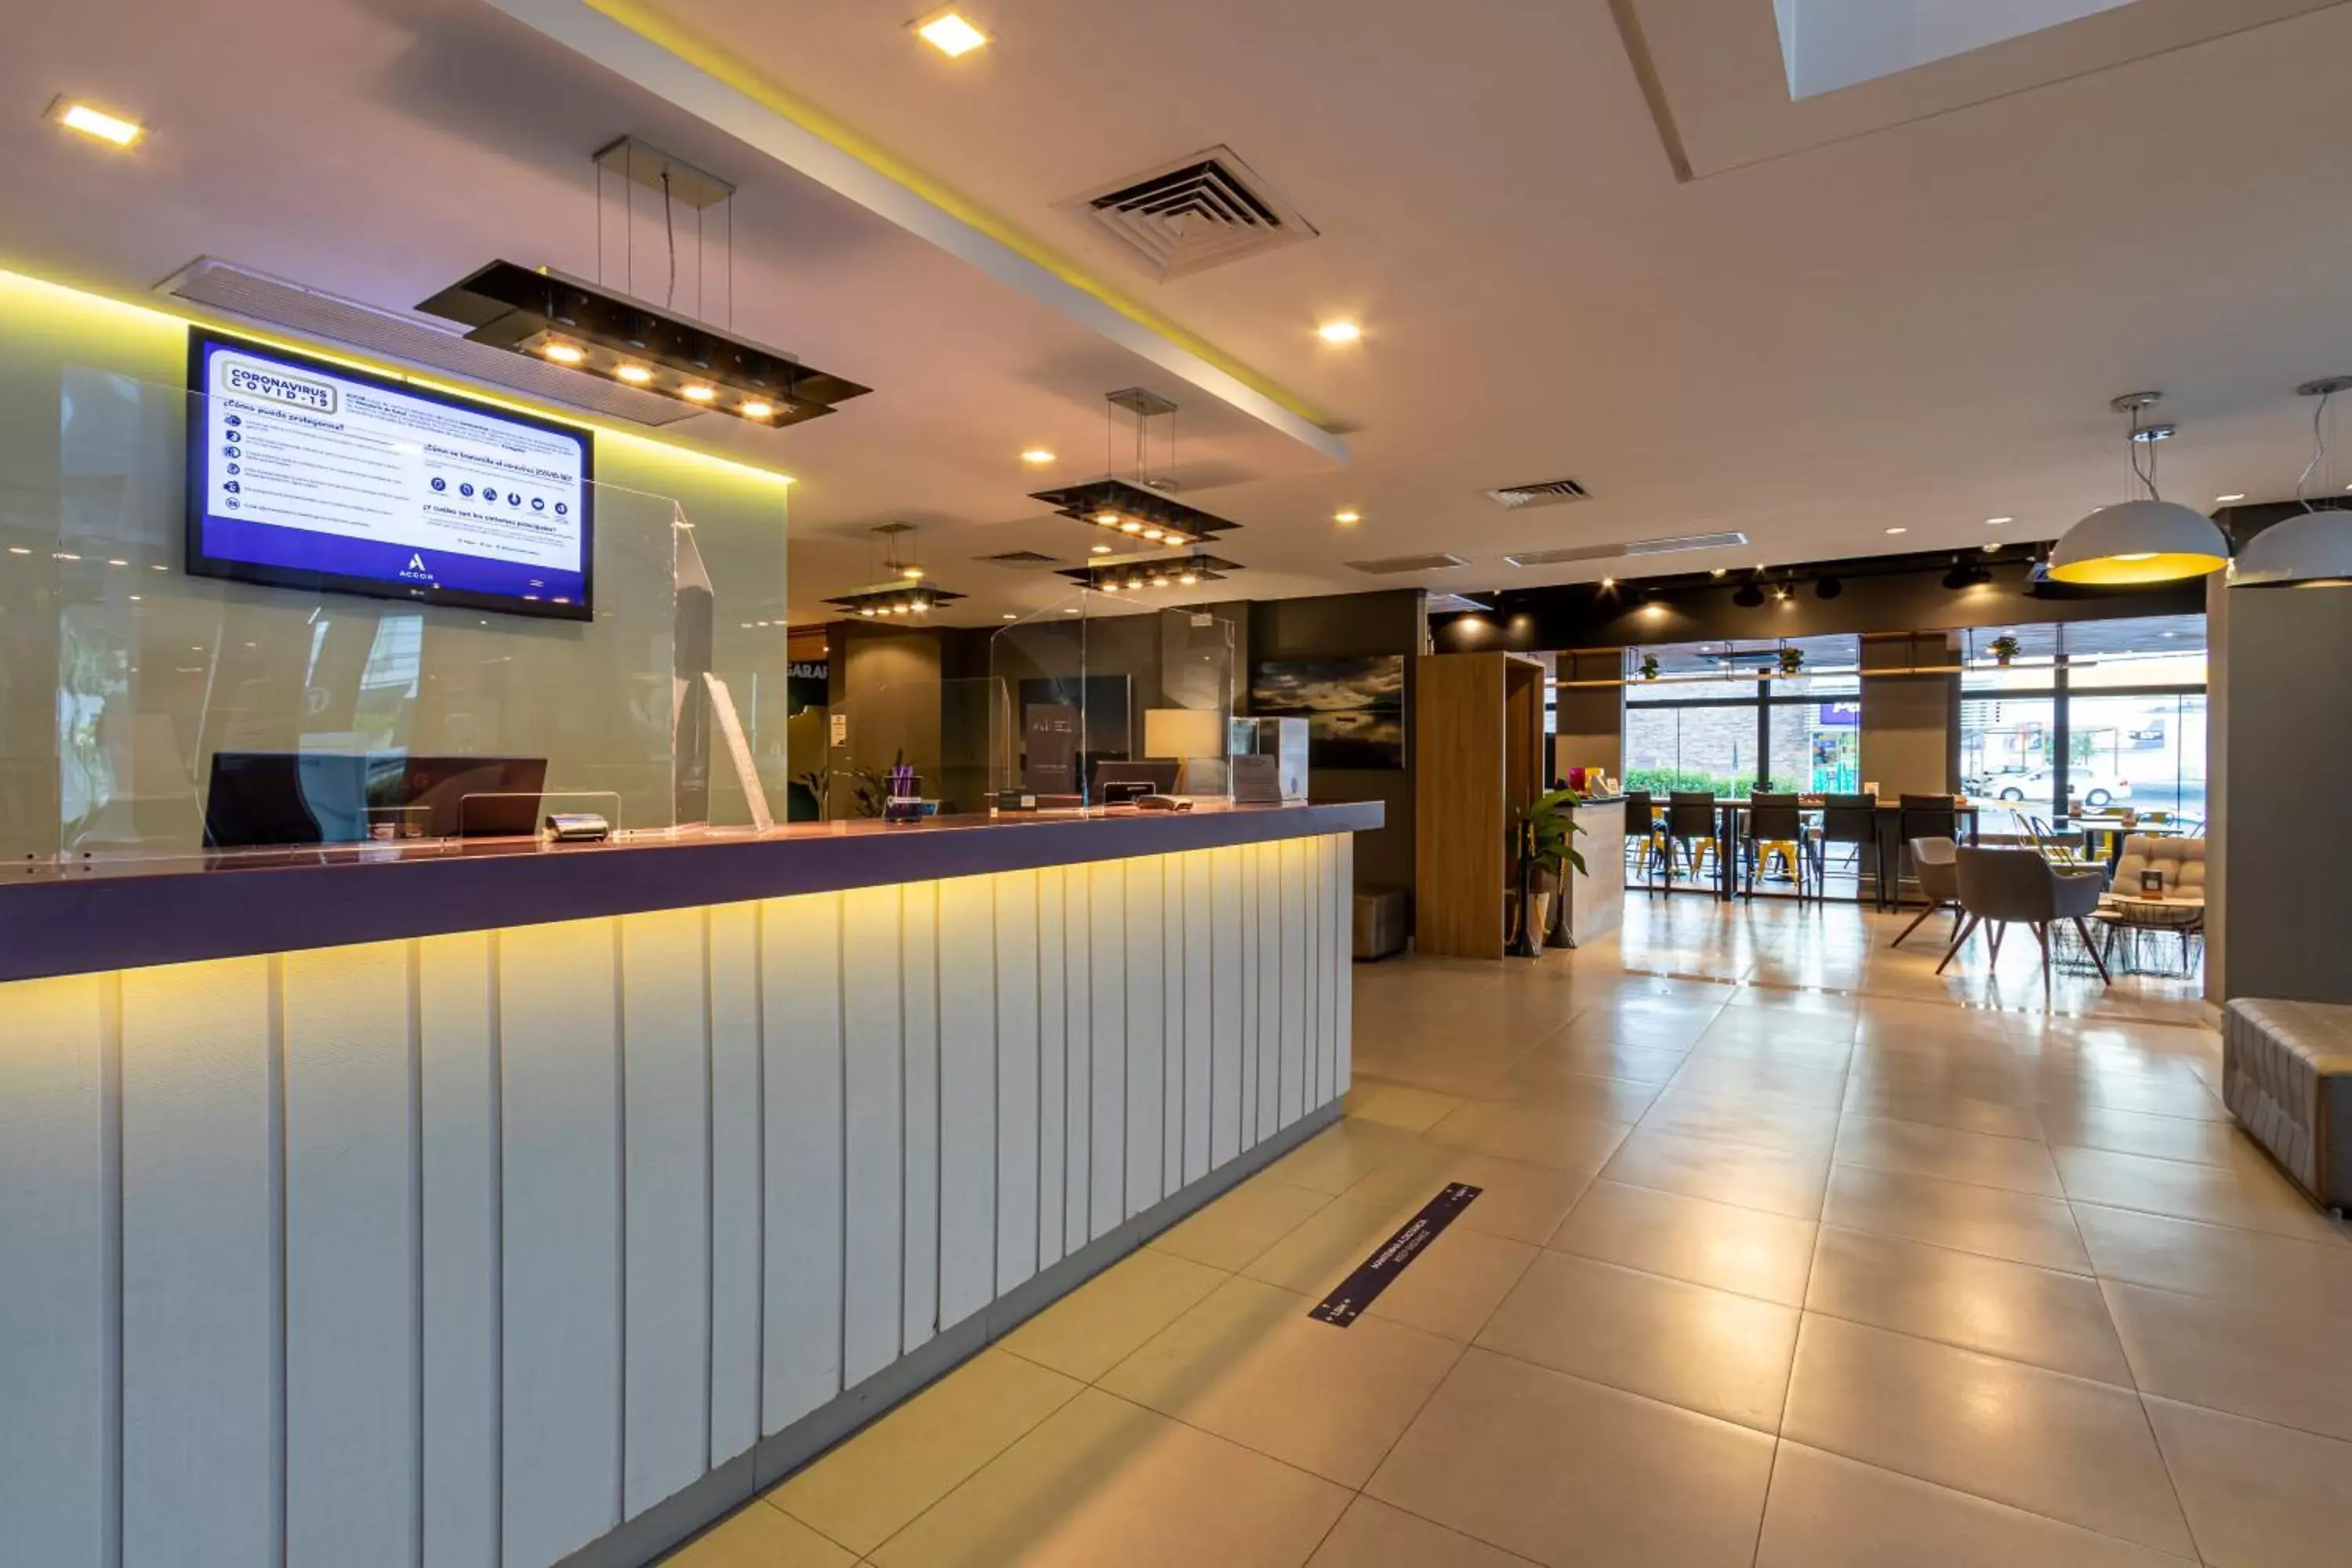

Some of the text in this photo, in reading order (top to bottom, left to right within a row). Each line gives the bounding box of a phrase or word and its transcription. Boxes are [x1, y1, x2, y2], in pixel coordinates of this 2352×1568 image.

[232, 368, 328, 398] CORONAVIRUS
[232, 377, 328, 407] COVID-19
[399, 570, 434, 581] ACCOR
